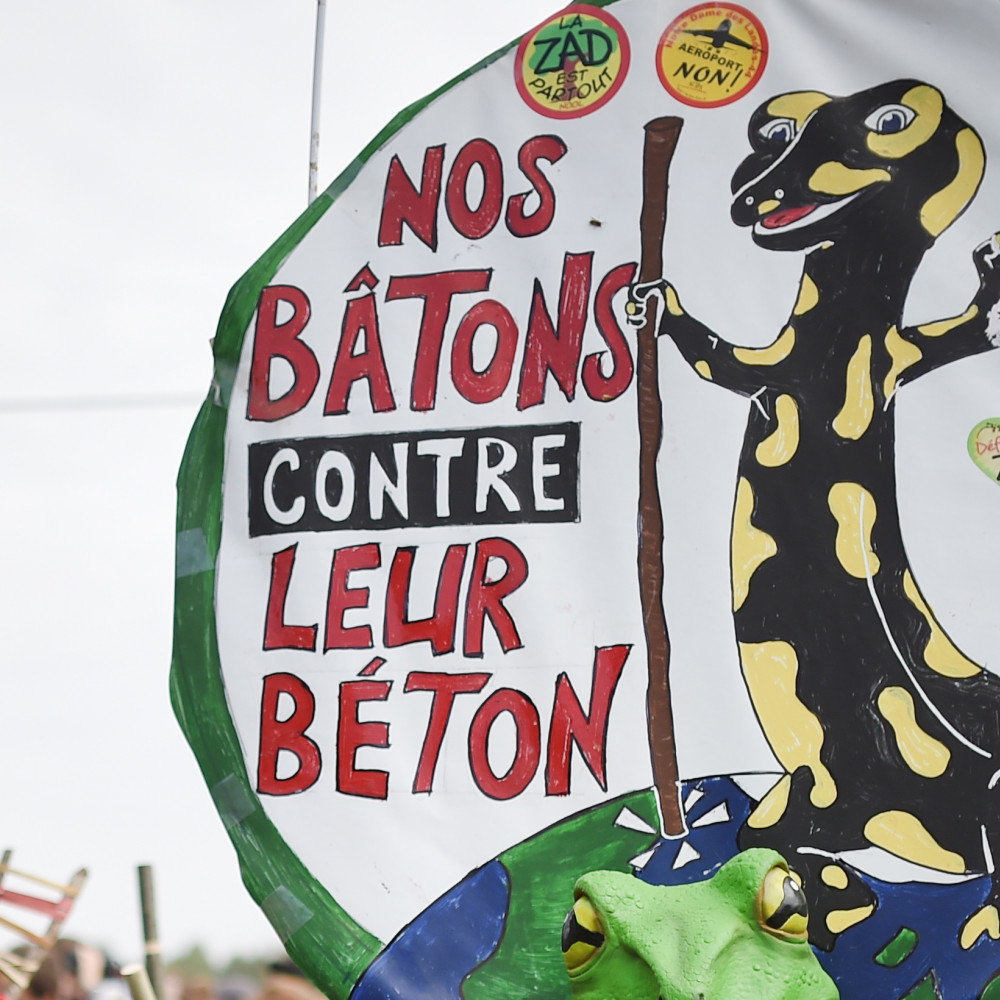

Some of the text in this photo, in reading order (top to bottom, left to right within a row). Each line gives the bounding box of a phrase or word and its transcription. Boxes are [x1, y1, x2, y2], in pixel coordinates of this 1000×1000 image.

[559, 14, 583, 29] LA
[690, 9, 722, 22] Dame
[726, 11, 744, 24] des
[528, 67, 613, 101] PARTOUT
[533, 29, 613, 74] ZAD
[556, 69, 588, 85] EST
[377, 134, 568, 252] NOS
[245, 251, 638, 422] BÂTONS
[263, 434, 567, 525] CONTRE
[262, 537, 530, 658] LEUR
[256, 644, 634, 801] BÉTON
